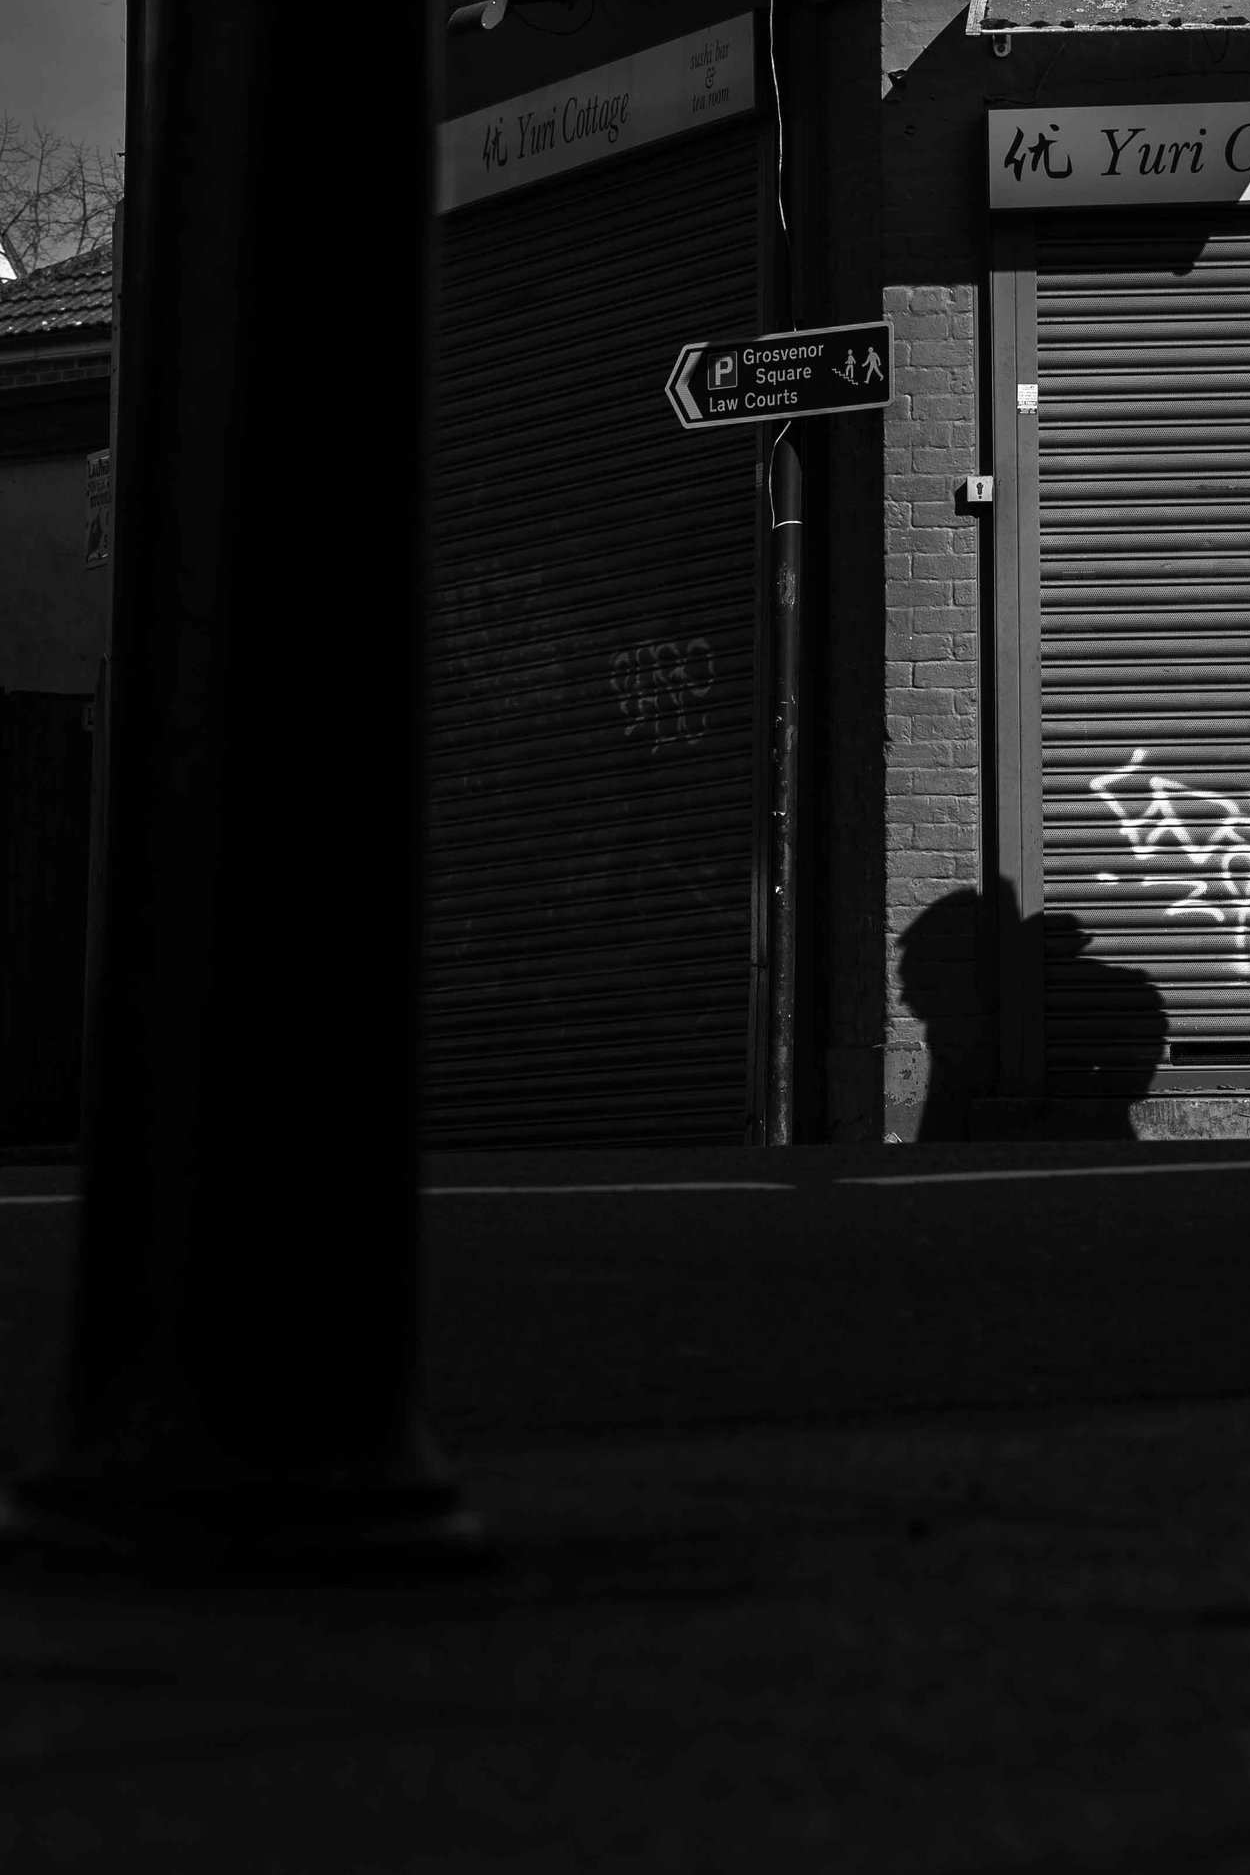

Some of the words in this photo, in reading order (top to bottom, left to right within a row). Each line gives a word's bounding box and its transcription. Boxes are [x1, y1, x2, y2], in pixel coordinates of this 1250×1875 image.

[690, 43, 713, 69] sushi
[715, 39, 731, 62] bar
[705, 65, 716, 89] &
[692, 94, 706, 113] tea
[708, 88, 729, 107] room
[516, 108, 557, 160] Yuri
[562, 92, 629, 143] Cottage
[1100, 127, 1207, 177] Yuri
[742, 343, 825, 366] Grosvenor
[714, 356, 734, 386] P
[755, 366, 813, 386] Square
[708, 396, 739, 413] Law
[744, 388, 798, 409] Courts
